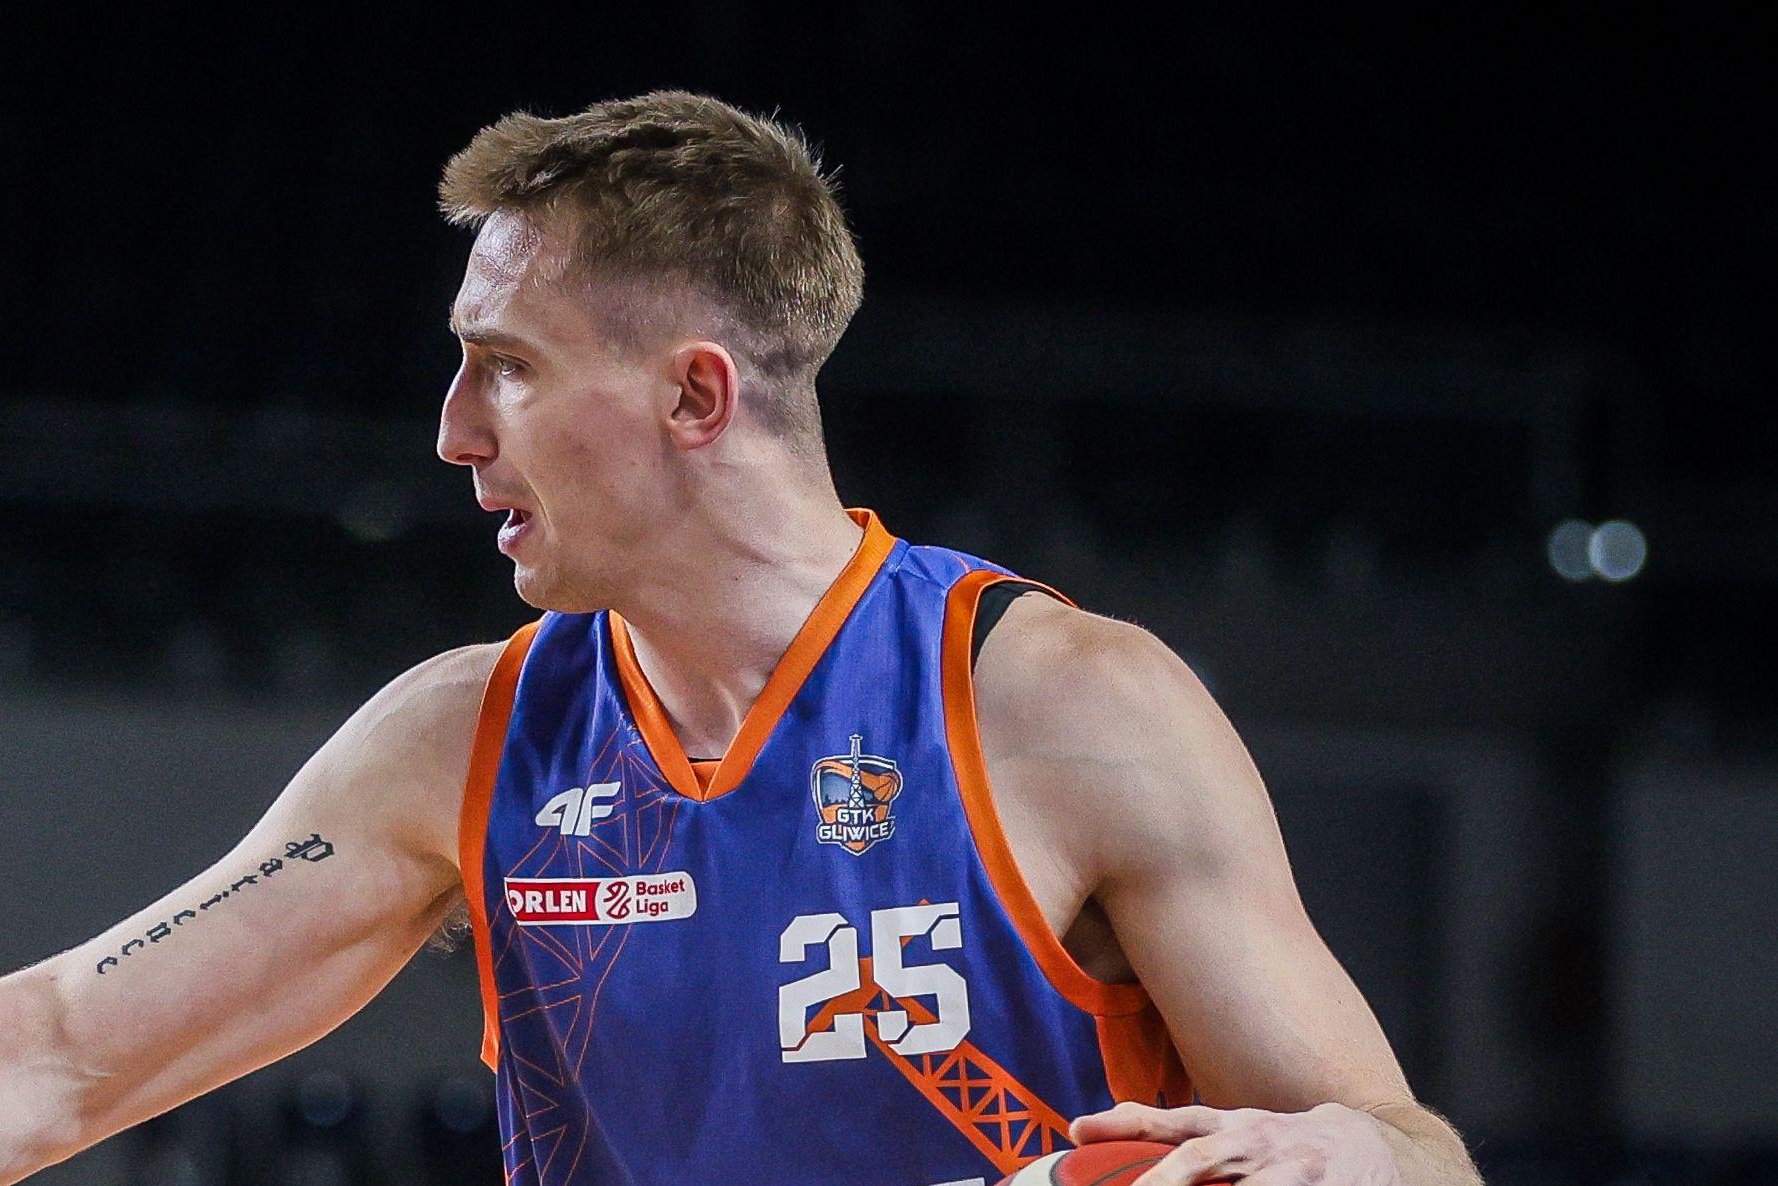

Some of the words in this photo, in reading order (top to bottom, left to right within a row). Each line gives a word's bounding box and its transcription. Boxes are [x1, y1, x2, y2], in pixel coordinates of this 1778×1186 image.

[535, 781, 621, 837] 4F
[837, 808, 874, 824] GTK
[818, 822, 889, 842] GLIWICE
[635, 879, 685, 896] Basket
[506, 889, 587, 914] ORLEN
[635, 899, 670, 917] Liga
[778, 901, 972, 1063] 25
